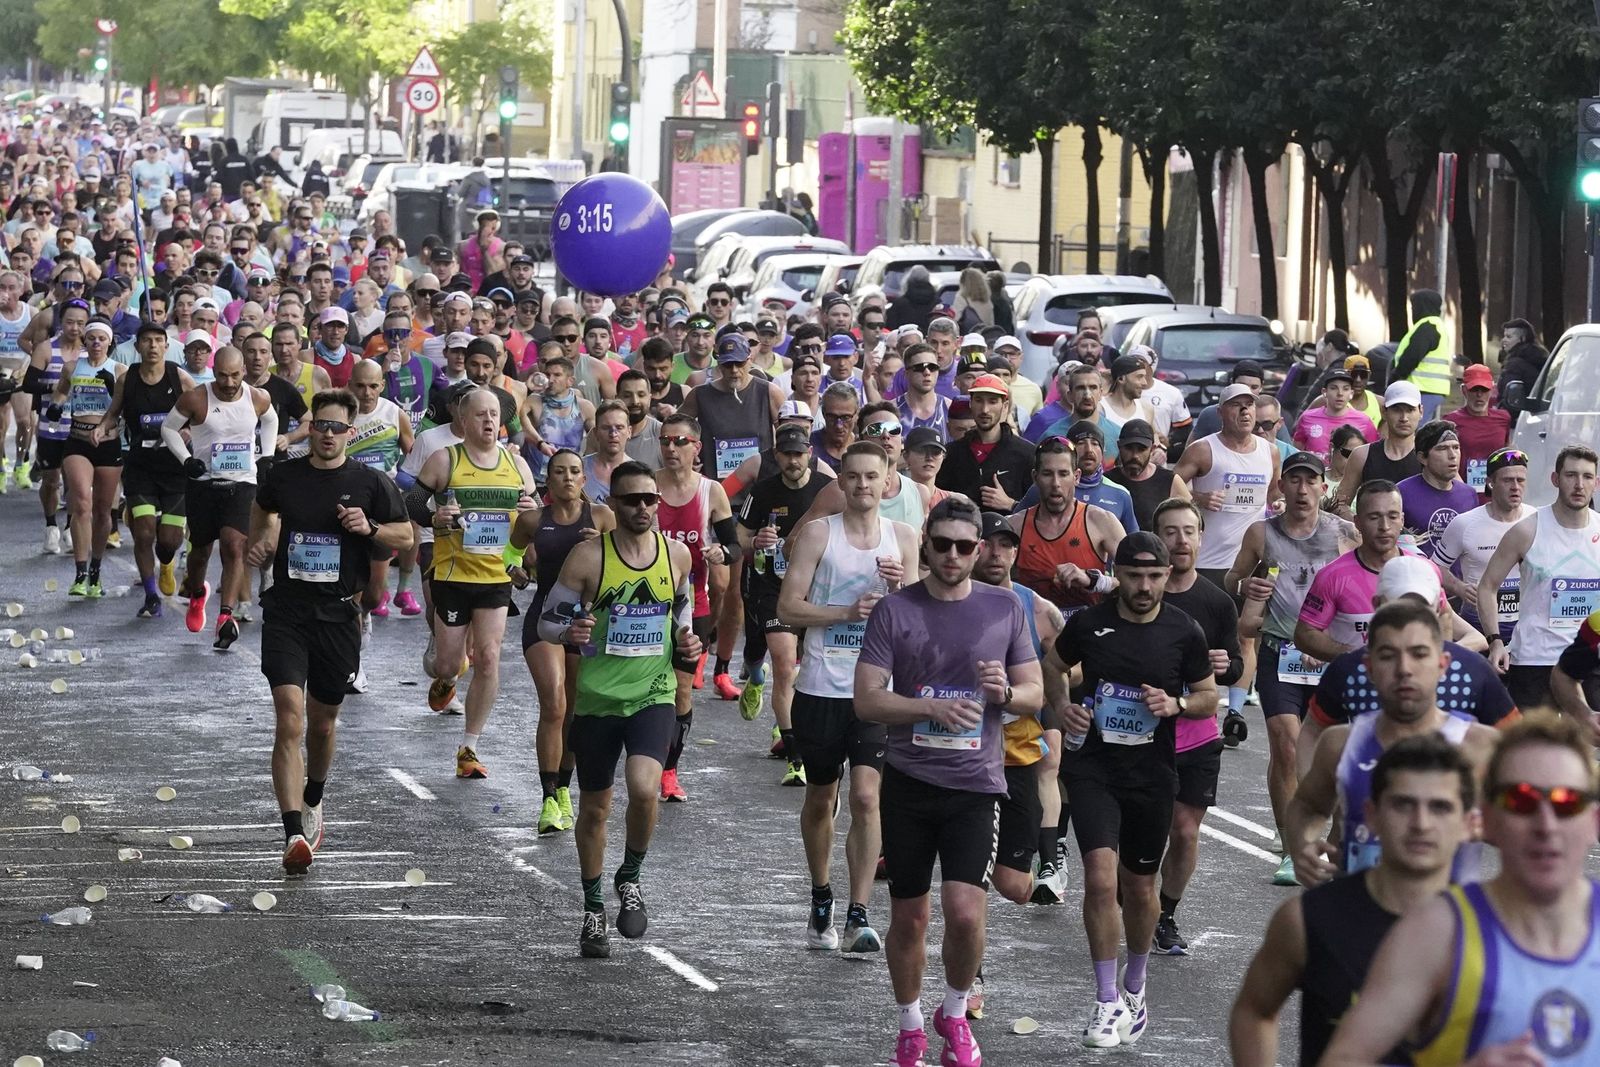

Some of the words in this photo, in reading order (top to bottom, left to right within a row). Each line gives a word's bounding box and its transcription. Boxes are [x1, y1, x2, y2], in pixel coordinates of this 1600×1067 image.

[413, 90, 434, 101] 30
[577, 203, 613, 234] 3:15
[363, 424, 386, 438] STEEL
[219, 461, 243, 470] ABDEL
[464, 490, 514, 500] CORNWALL
[1235, 495, 1254, 504] MAR
[476, 535, 499, 545] JOHN
[289, 560, 309, 570] MARC
[311, 562, 339, 571] JULIAN
[631, 606, 661, 615] ZURICH
[1561, 606, 1593, 615] HENRY
[630, 623, 647, 631] 6252
[847, 624, 865, 632] 9506
[608, 631, 663, 644] JOZZELITO
[1116, 706, 1137, 716] 9520
[1105, 716, 1143, 732] ISAAC
